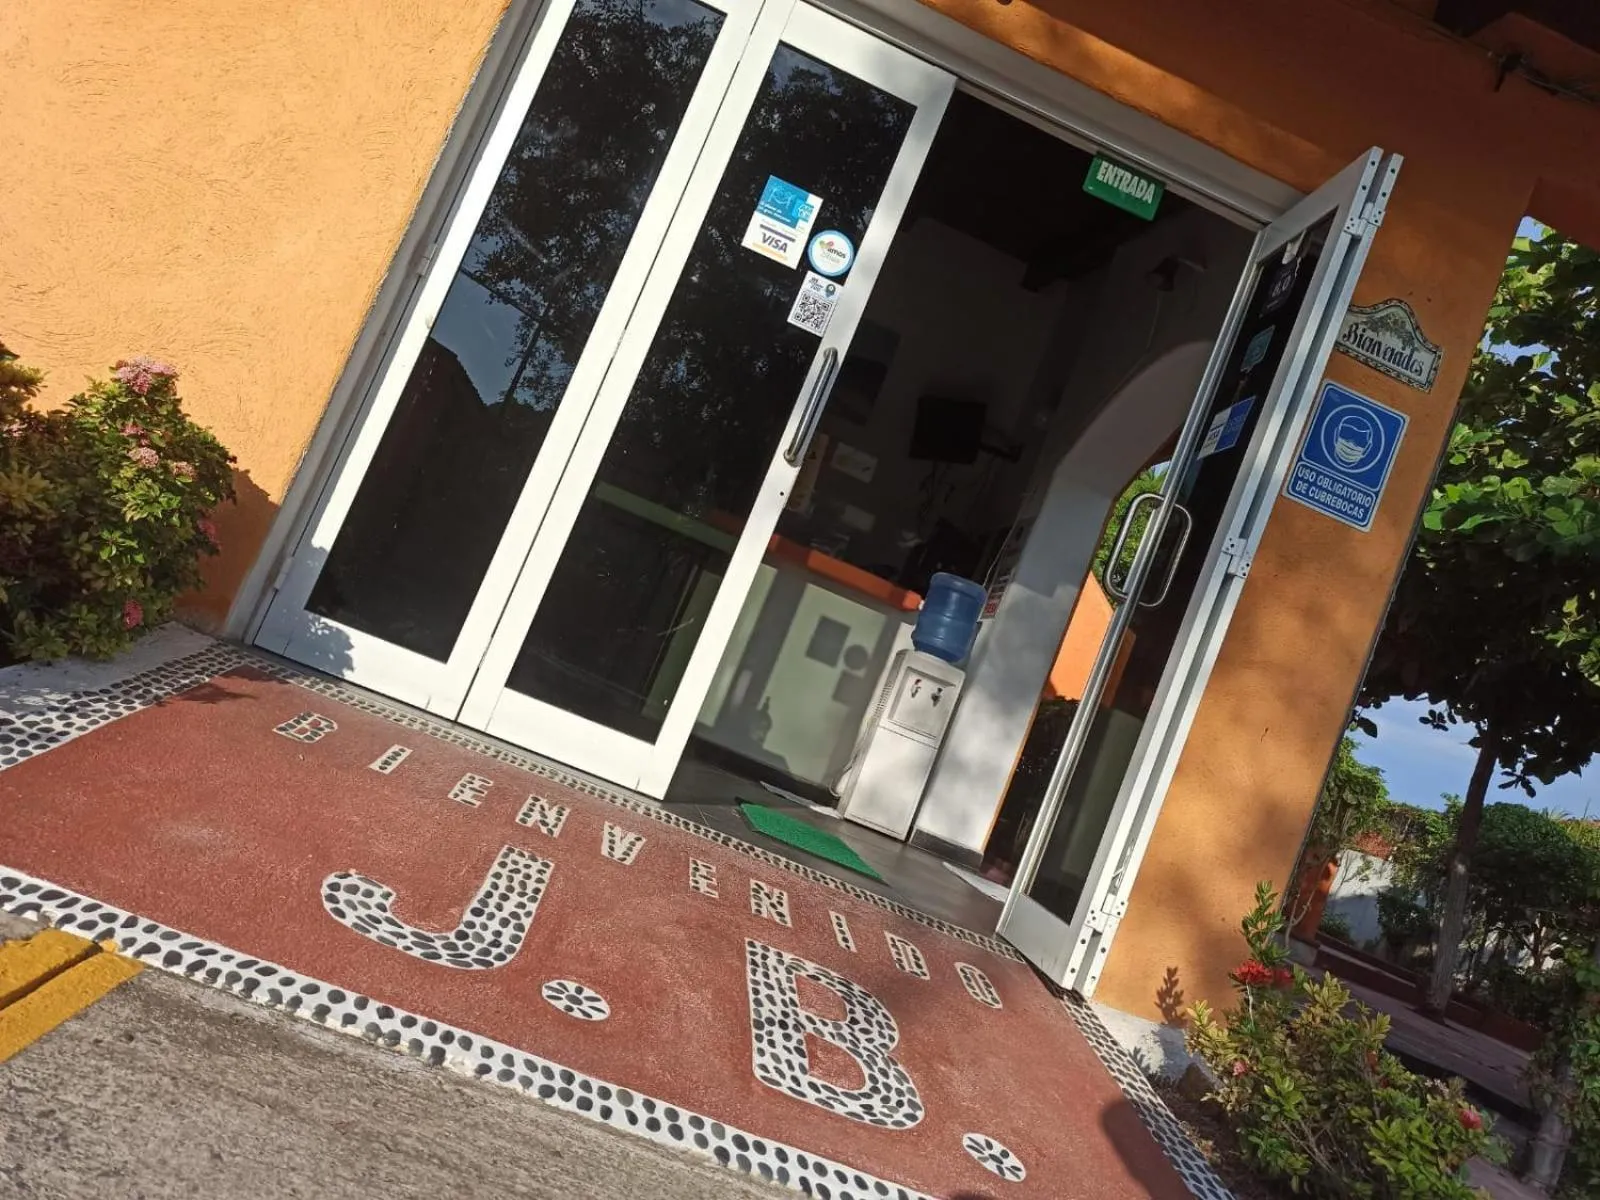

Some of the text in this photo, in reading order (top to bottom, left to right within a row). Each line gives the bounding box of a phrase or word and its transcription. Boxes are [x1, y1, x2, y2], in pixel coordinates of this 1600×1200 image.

[1096, 161, 1155, 204] ENTRADA
[762, 232, 788, 253] VISA
[1296, 481, 1365, 519] DE CUBREBOCAS
[1298, 467, 1373, 507] USO OBLIGATORIO
